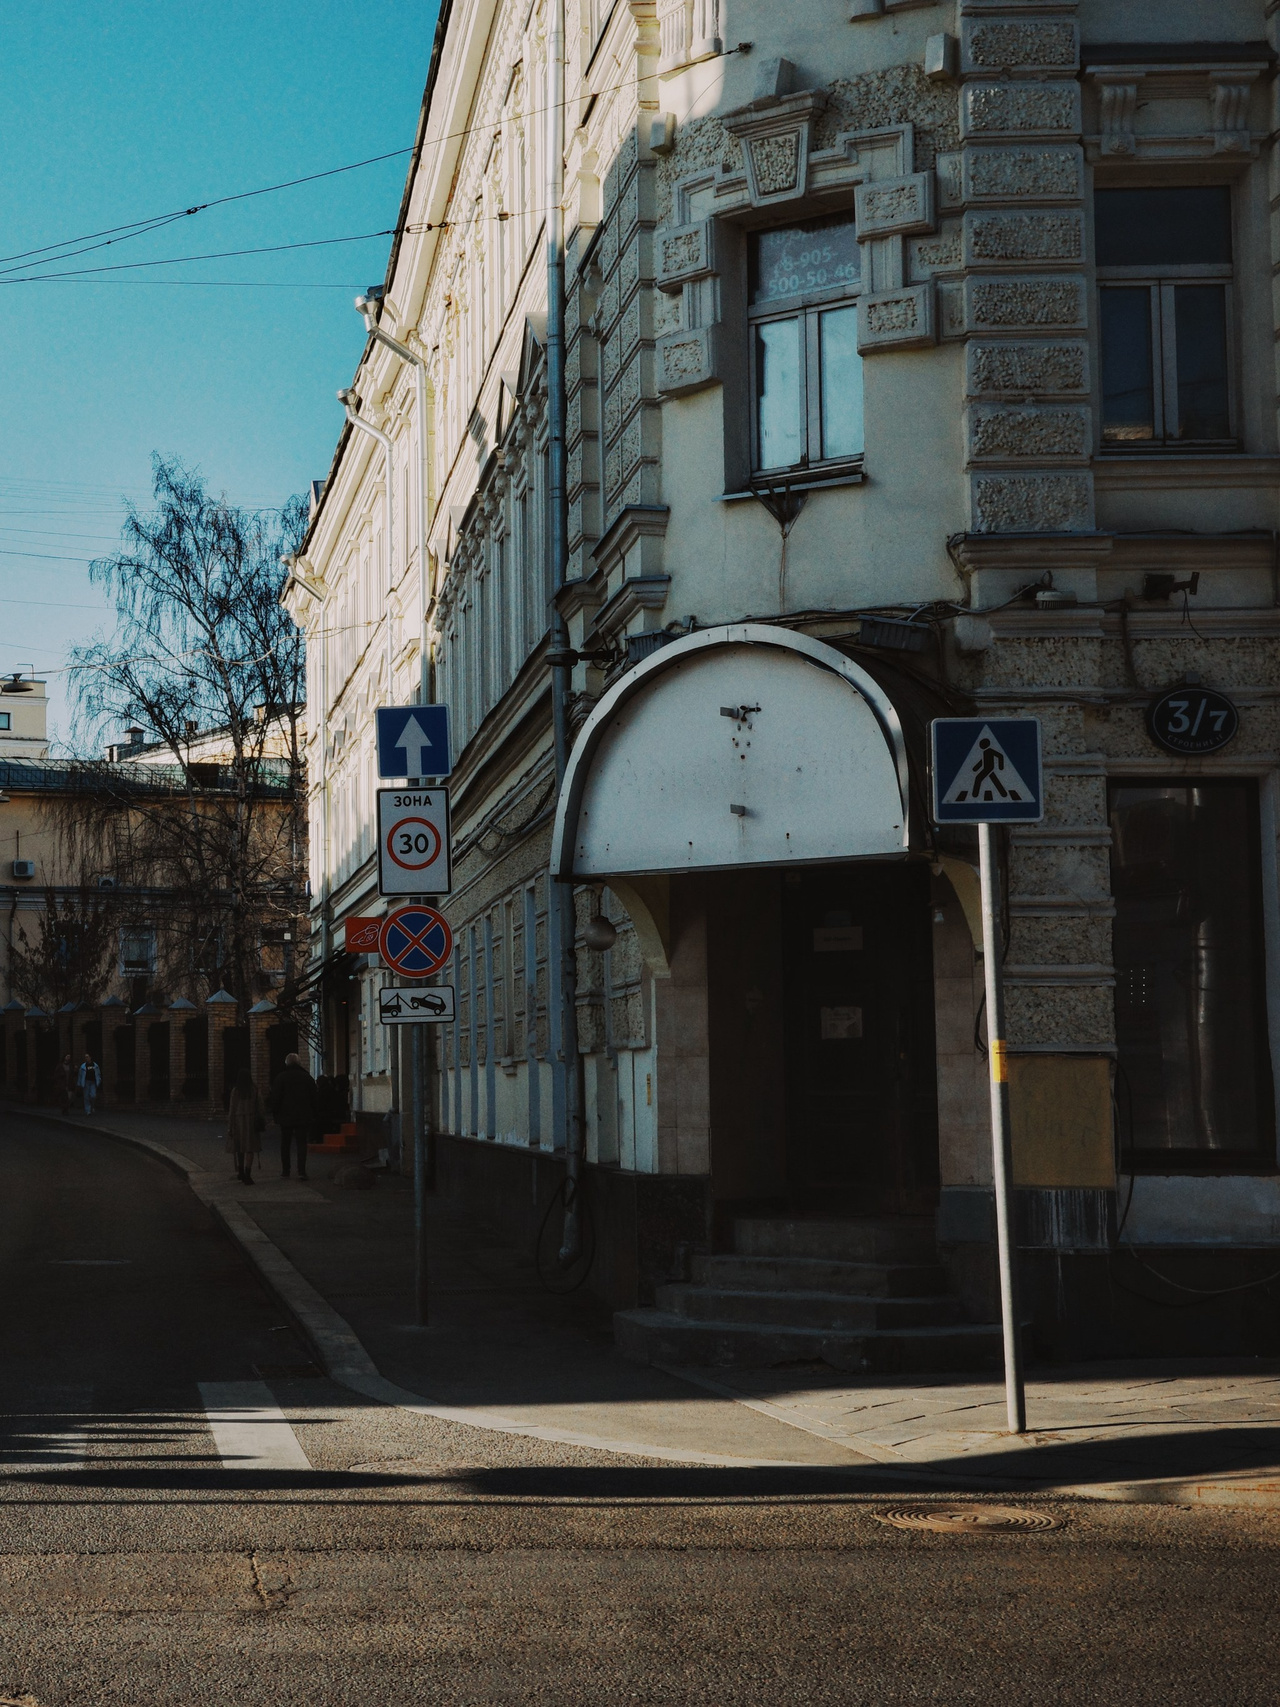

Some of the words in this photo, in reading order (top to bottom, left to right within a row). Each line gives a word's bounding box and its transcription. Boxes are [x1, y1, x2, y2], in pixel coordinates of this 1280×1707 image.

[1167, 698, 1229, 737] 3/7
[1167, 734, 1214, 748] СТРОЕНИЕ
[393, 795, 433, 807] ЗОНА
[399, 833, 429, 855] 30
